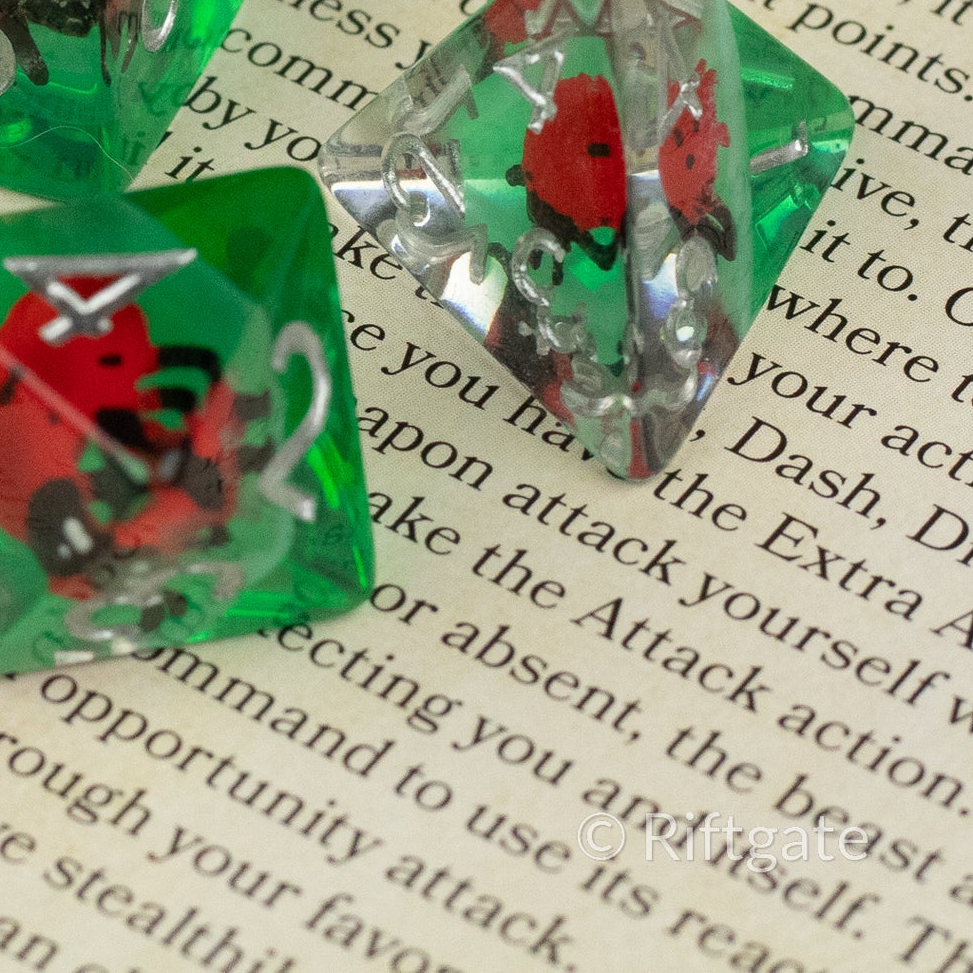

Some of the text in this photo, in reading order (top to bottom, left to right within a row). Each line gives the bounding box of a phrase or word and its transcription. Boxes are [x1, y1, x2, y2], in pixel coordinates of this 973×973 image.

[787, 4, 973, 102] points.
[1, 248, 199, 347] 4
[185, 74, 257, 132] by
[726, 351, 878, 430] your
[800, 219, 919, 303] it to.
[269, 320, 331, 523] 2
[379, 341, 924, 622] you the Extra
[724, 415, 887, 530] Dash,
[470, 544, 567, 610] the
[570, 596, 771, 714] Attack
[775, 703, 970, 818] action.
[501, 482, 685, 587] attack
[677, 571, 952, 707] yourself
[39, 660, 383, 866] opportunity
[383, 854, 577, 973] attack.
[369, 582, 440, 626] or
[439, 620, 642, 743] absent,
[664, 726, 764, 792] the
[772, 772, 943, 884] beast
[450, 714, 575, 788] you
[145, 824, 304, 910] your
[393, 763, 454, 812] to
[464, 803, 573, 872] use
[579, 853, 660, 919] its
